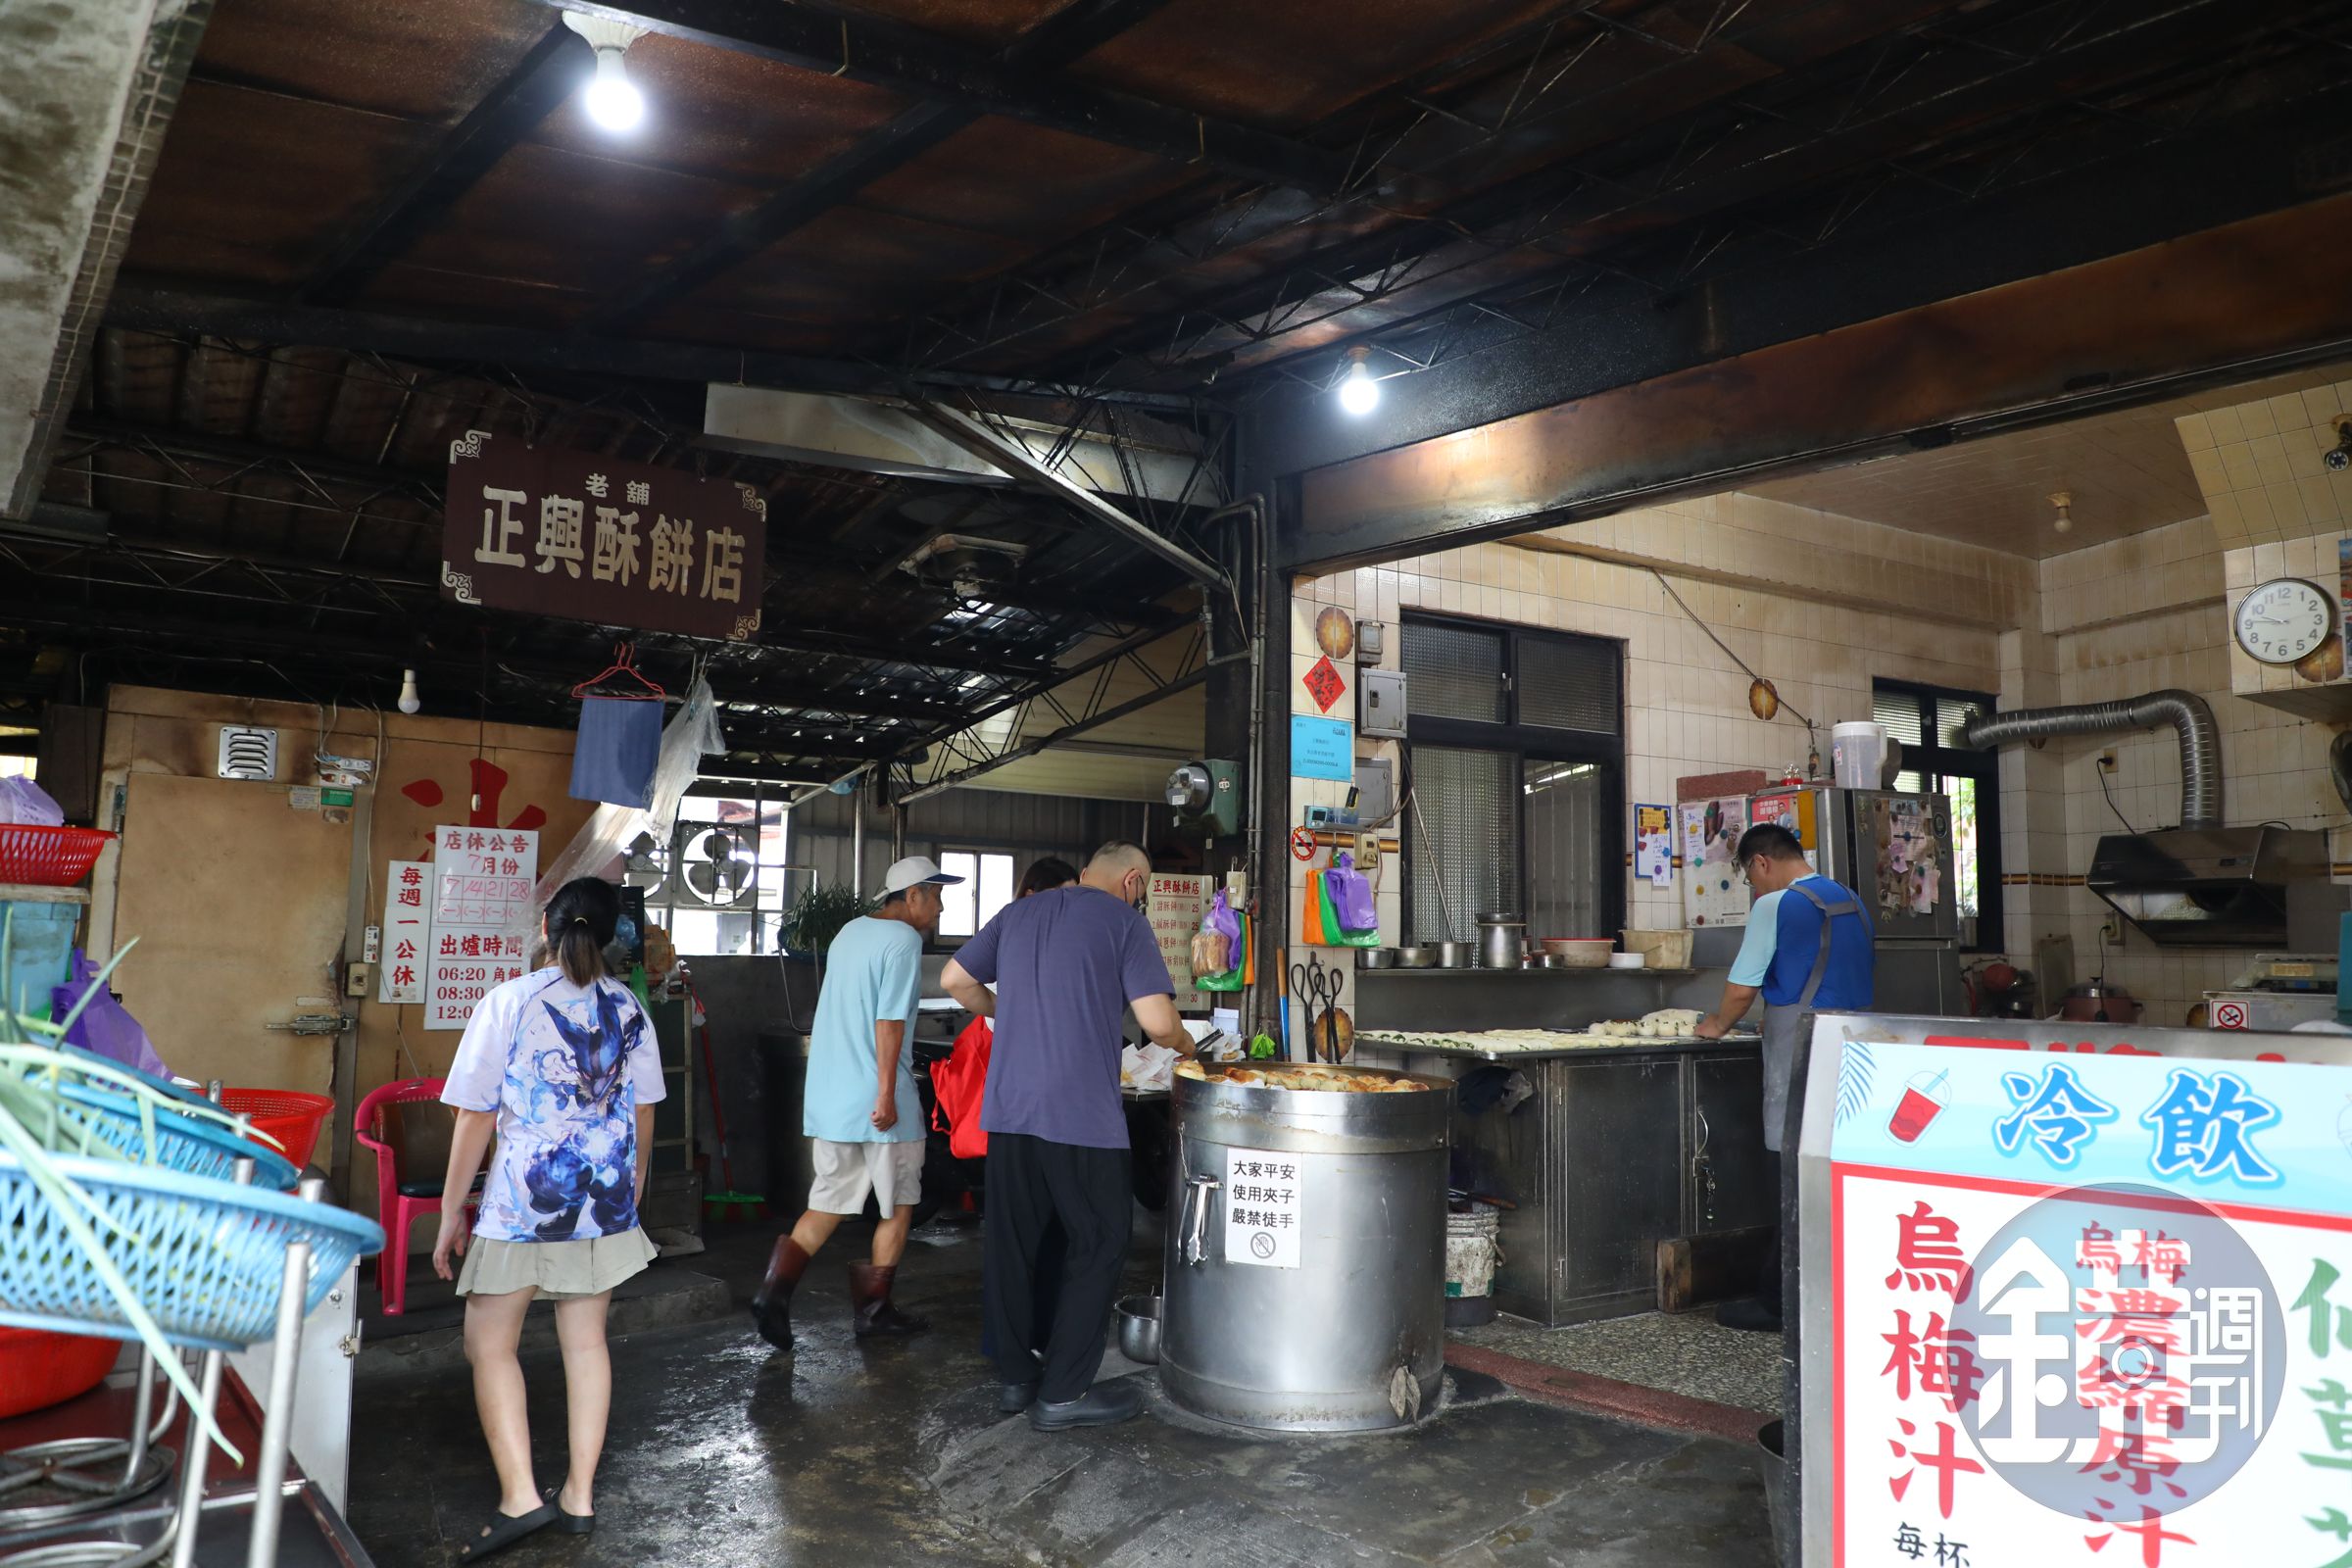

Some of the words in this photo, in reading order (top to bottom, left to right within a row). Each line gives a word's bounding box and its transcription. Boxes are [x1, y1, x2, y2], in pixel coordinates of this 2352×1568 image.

[585, 473, 651, 507] 老舖
[474, 485, 746, 604] 正興酥餅店
[444, 831, 530, 854] 店休公告
[510, 881, 529, 900] 28
[392, 866, 423, 986] 每週一公休
[438, 967, 486, 981] 06:20
[437, 986, 485, 1001] 08:30
[437, 1005, 473, 1019] 12:0
[1995, 1064, 2279, 1182] 冷飲
[1233, 1160, 1296, 1180] 大家平安
[1233, 1184, 1296, 1204] 使用夾子
[1232, 1208, 1295, 1229] 嚴禁徒手
[1880, 1200, 1986, 1520] 烏梅汁
[1892, 1522, 1971, 1568] 每杯
